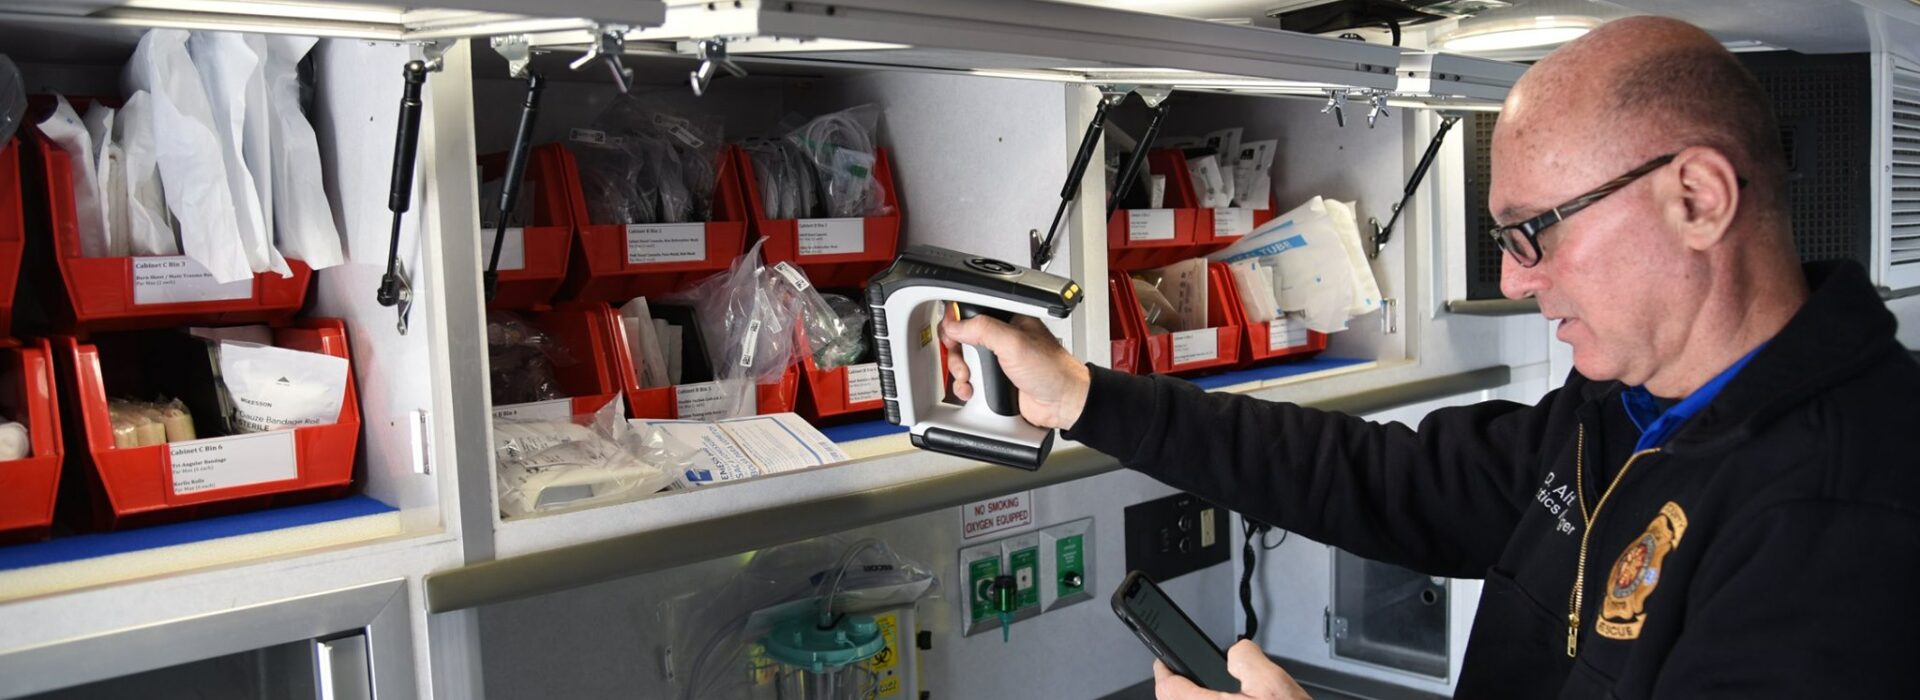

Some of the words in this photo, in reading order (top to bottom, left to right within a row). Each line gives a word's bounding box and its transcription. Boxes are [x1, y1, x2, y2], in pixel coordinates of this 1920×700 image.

[135, 262, 161, 270] Cabinet
[239, 420, 270, 432] STERILE
[240, 410, 264, 422] Gauze
[266, 416, 302, 426] Bandage
[1536, 488, 1561, 515] tics
[1552, 484, 1576, 507] Alt
[974, 504, 985, 516] NO
[988, 496, 1019, 512] SMOKING
[966, 518, 994, 534] OXYGEN
[997, 510, 1028, 526] EQUIPPED
